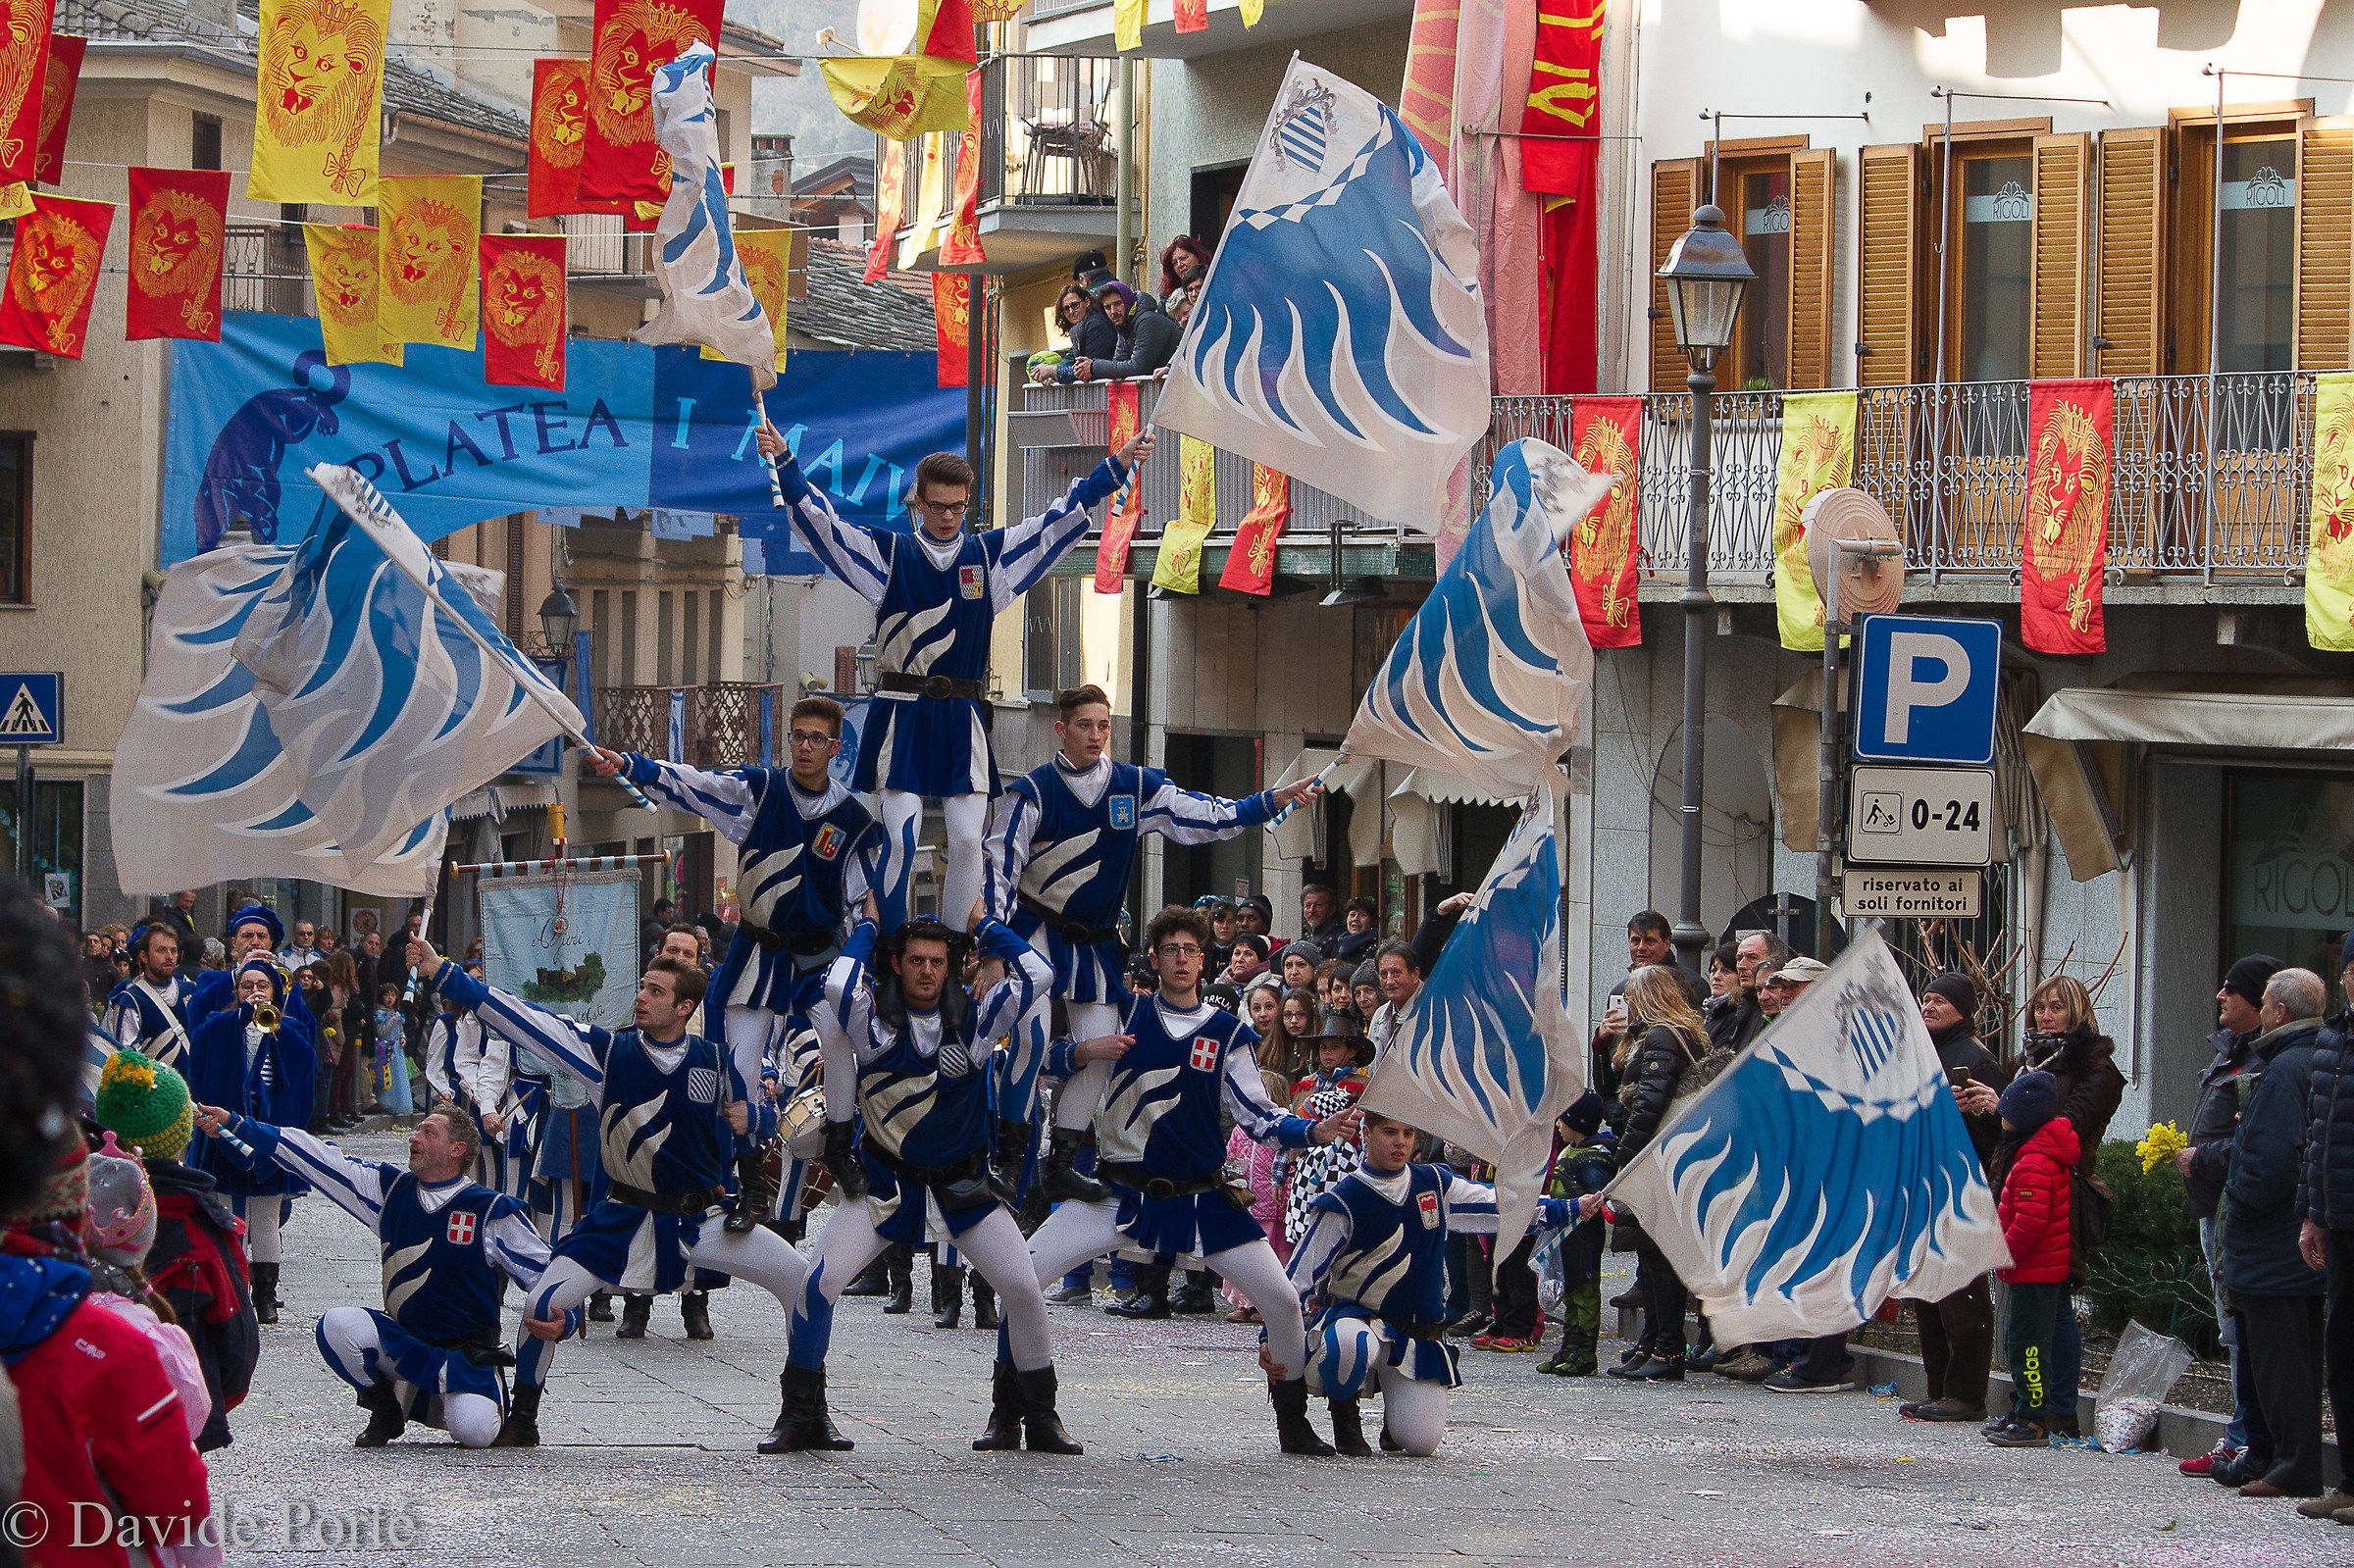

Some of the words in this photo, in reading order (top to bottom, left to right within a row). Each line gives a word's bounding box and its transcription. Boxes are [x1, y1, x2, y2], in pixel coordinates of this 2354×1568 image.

[2246, 185, 2285, 206] RIGOLI
[1992, 200, 2029, 219] RIGOLI
[1763, 213, 1790, 232] RIGO
[344, 397, 630, 492] PLATEA
[671, 396, 696, 450] I
[1884, 632, 1971, 744] P
[1912, 798, 1980, 832] 0-24
[1863, 877, 1941, 892] riservato
[1948, 878, 1964, 892] ai
[1858, 896, 1888, 910] soli
[1896, 896, 1968, 911] fornitori
[2023, 1345, 2044, 1408] adidas
